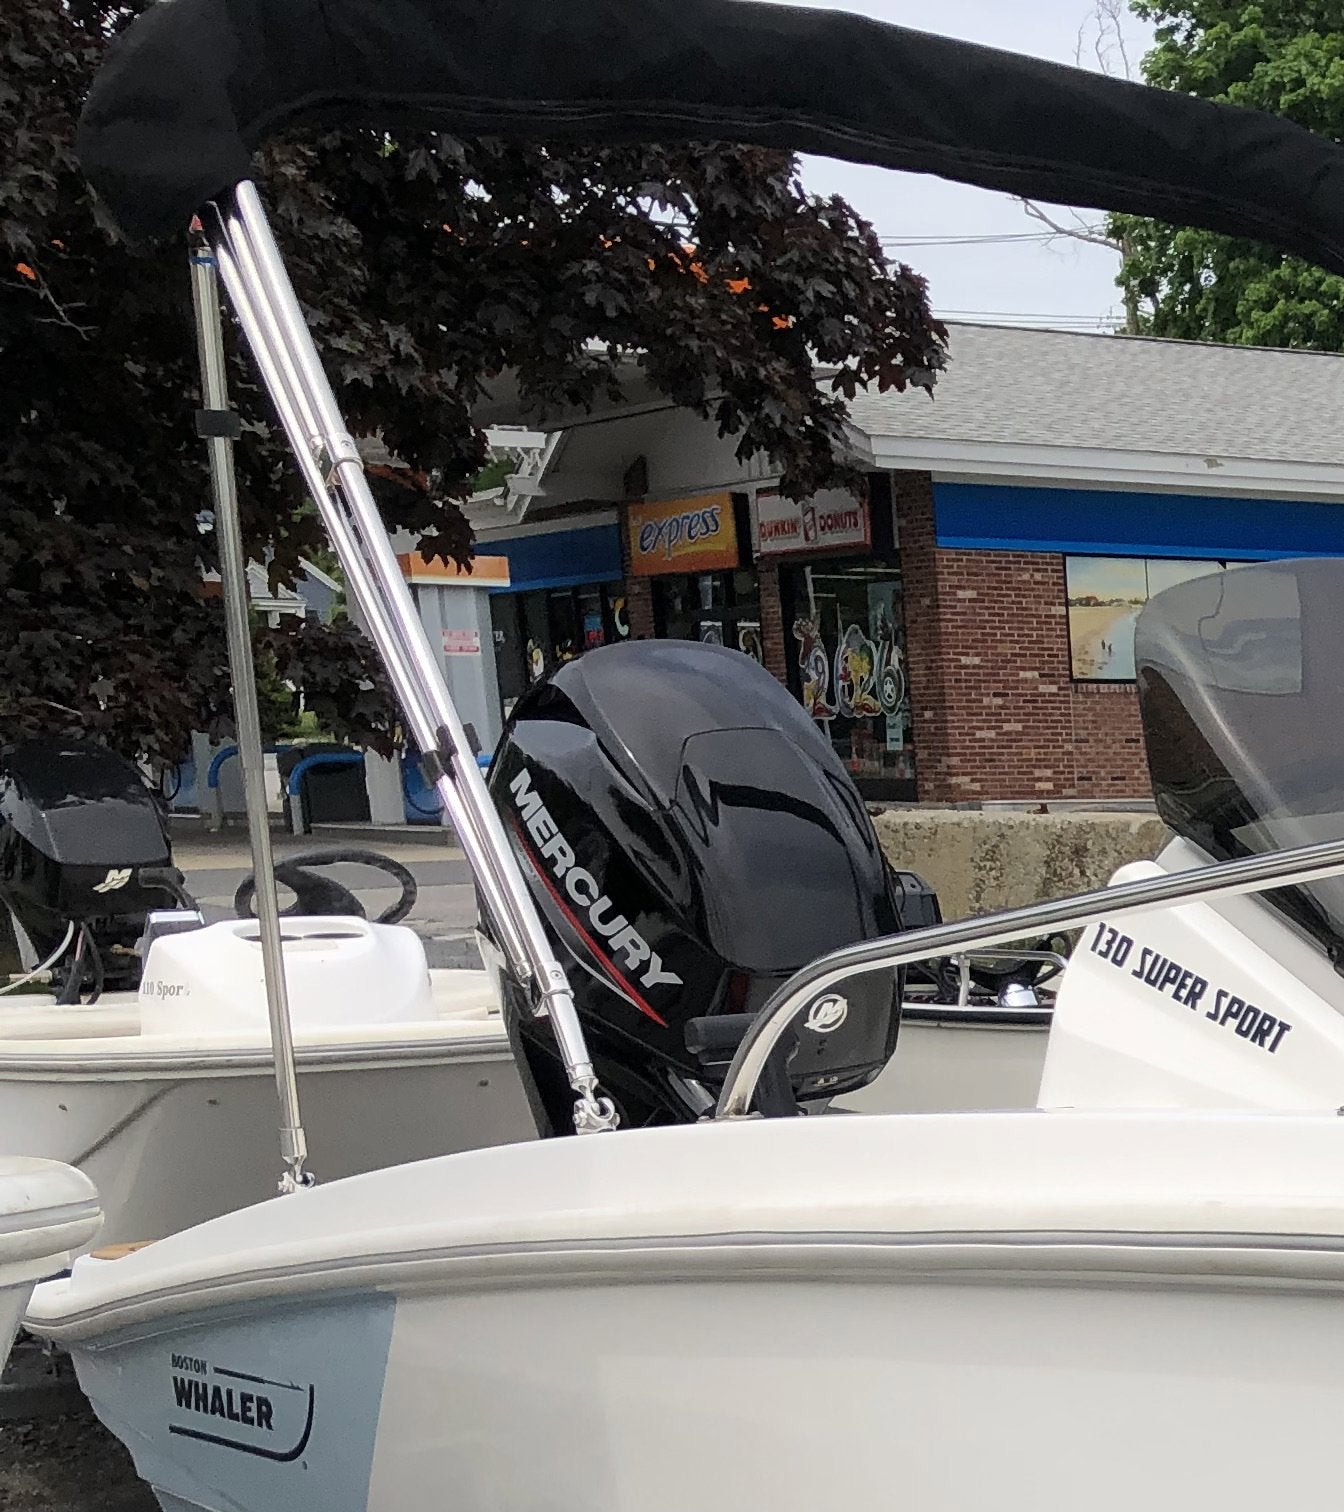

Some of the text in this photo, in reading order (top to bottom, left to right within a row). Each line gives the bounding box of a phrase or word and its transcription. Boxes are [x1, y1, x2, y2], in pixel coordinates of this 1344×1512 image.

[639, 504, 721, 561] express
[819, 511, 859, 532] DONUTS
[509, 768, 684, 989] MERCURY
[143, 981, 155, 995] 110
[1090, 921, 1293, 1054] 130 SUPER SPORT
[171, 1353, 207, 1375] BOSTON
[172, 1375, 274, 1431] WHALER
